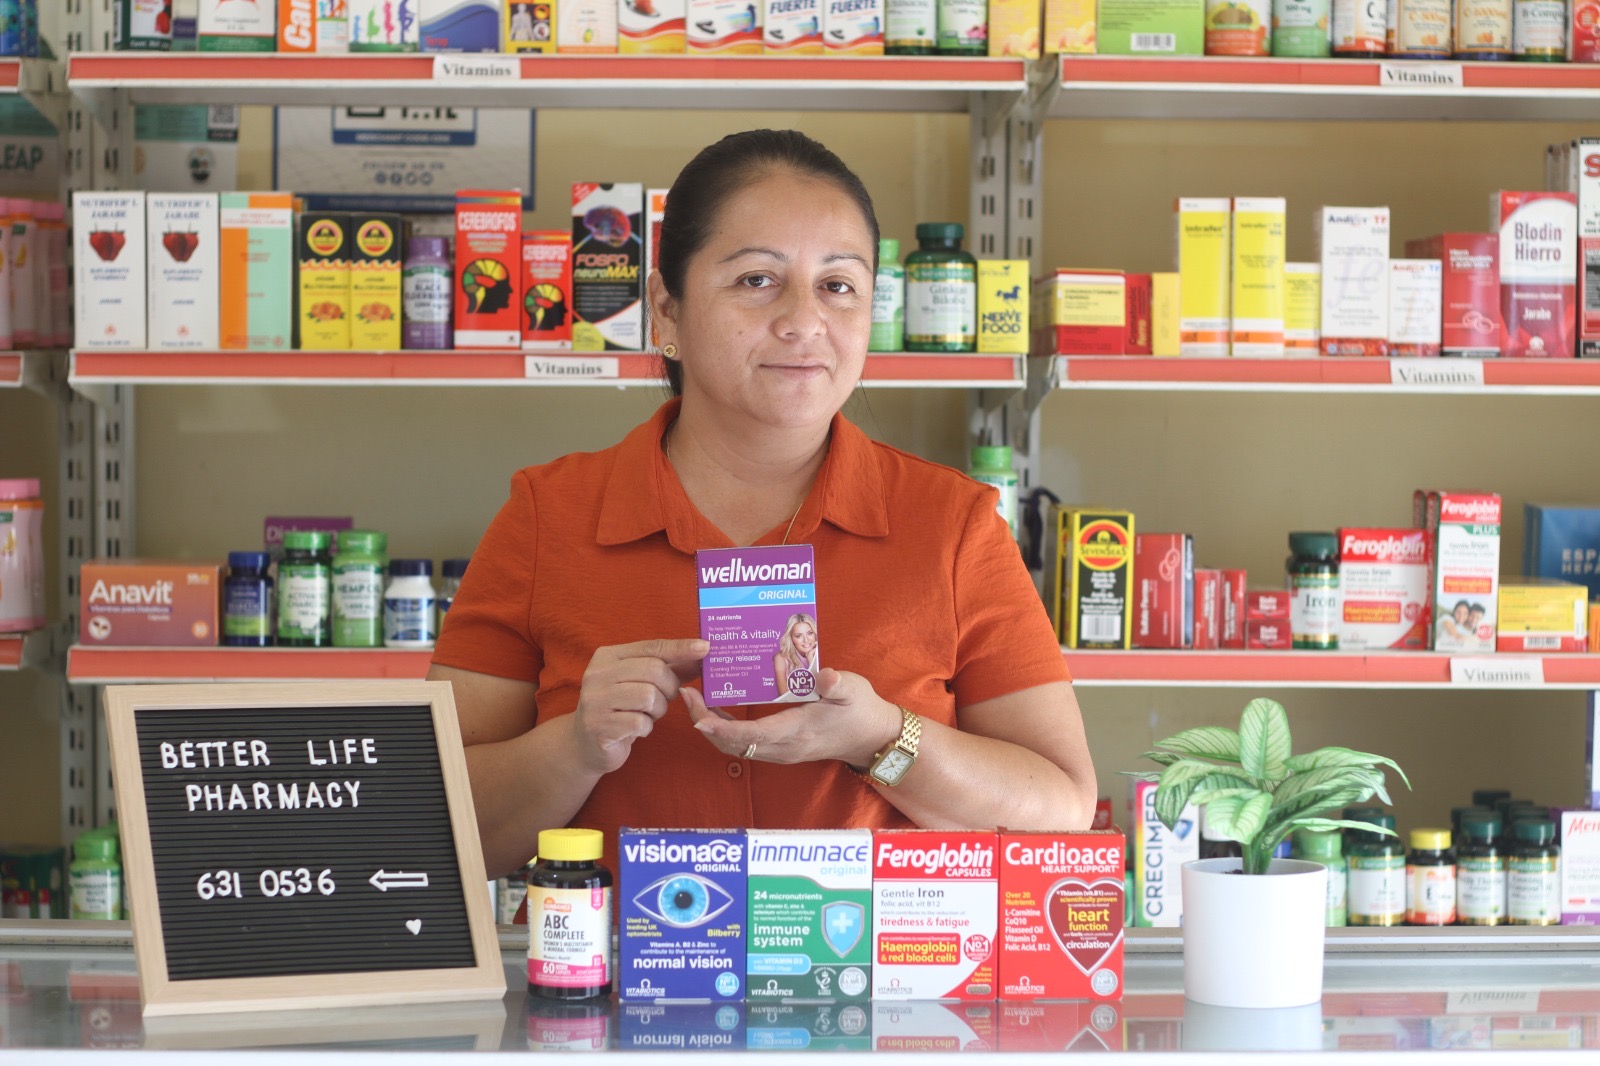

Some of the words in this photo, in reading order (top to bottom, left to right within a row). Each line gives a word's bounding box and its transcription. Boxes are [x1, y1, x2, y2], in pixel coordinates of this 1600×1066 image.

[769, 0, 818, 14] FUERTE
[830, 0, 879, 14] FUERTE
[442, 63, 512, 77] Vitamins
[1386, 69, 1454, 84] Vitamins
[0, 144, 44, 170] EAP
[1514, 221, 1563, 241] Blodin
[1514, 243, 1562, 261] Hierro
[981, 311, 1022, 323] NERVE
[981, 323, 1021, 333] FOOD
[534, 362, 603, 375] Vitamins
[1398, 368, 1476, 383] Vitamins
[1473, 525, 1498, 534] PLUS
[1343, 535, 1426, 561] Feroglobin
[701, 558, 812, 583] wellwoman
[88, 580, 172, 604] Anavit
[758, 589, 808, 600] ORIGINAL
[1305, 594, 1336, 608] Iron
[708, 631, 739, 641] health
[741, 631, 748, 639] &
[749, 630, 781, 640] vitality
[709, 656, 734, 664] energy
[735, 654, 761, 662] release
[1464, 667, 1531, 682] Vitamins
[160, 740, 271, 769] BETTER
[307, 738, 378, 766] LIFE
[185, 781, 360, 812] PHARMACY
[624, 839, 744, 863] visionace
[751, 839, 869, 862] immunace
[1005, 841, 1121, 865] Cardioace
[876, 842, 994, 874] Feroglobin
[694, 863, 742, 872] ORIGINAL
[819, 865, 867, 876] original
[945, 868, 992, 877] CAPSULES
[1041, 865, 1073, 873] HEART
[1073, 865, 1118, 873] SUPPORT
[197, 870, 243, 900] 631
[753, 891, 768, 900] 24
[881, 889, 915, 898] Gentle
[918, 888, 944, 898] Iron
[897, 900, 914, 908] acid,
[1005, 917, 1027, 925] CoQ10
[1068, 907, 1110, 922] heart
[543, 914, 569, 929] ABC
[880, 917, 925, 926] tiredness
[926, 917, 934, 926] &
[935, 917, 970, 928] fatigue
[1069, 922, 1108, 931] function
[543, 930, 585, 940] COMPLETE
[707, 929, 741, 938] Bilberry
[753, 923, 810, 935] immune
[753, 936, 803, 948] system
[881, 941, 958, 954] Haemoglobin
[1005, 943, 1020, 951] Folic
[1021, 943, 1037, 951] Acid,
[1038, 943, 1051, 951] B12
[1066, 940, 1110, 949] circulation
[633, 955, 685, 968] normal
[689, 955, 733, 968] vision
[881, 954, 887, 962] &
[888, 954, 904, 962] red
[906, 953, 934, 962] blood
[936, 953, 957, 962] cells
[543, 962, 555, 974] 60
